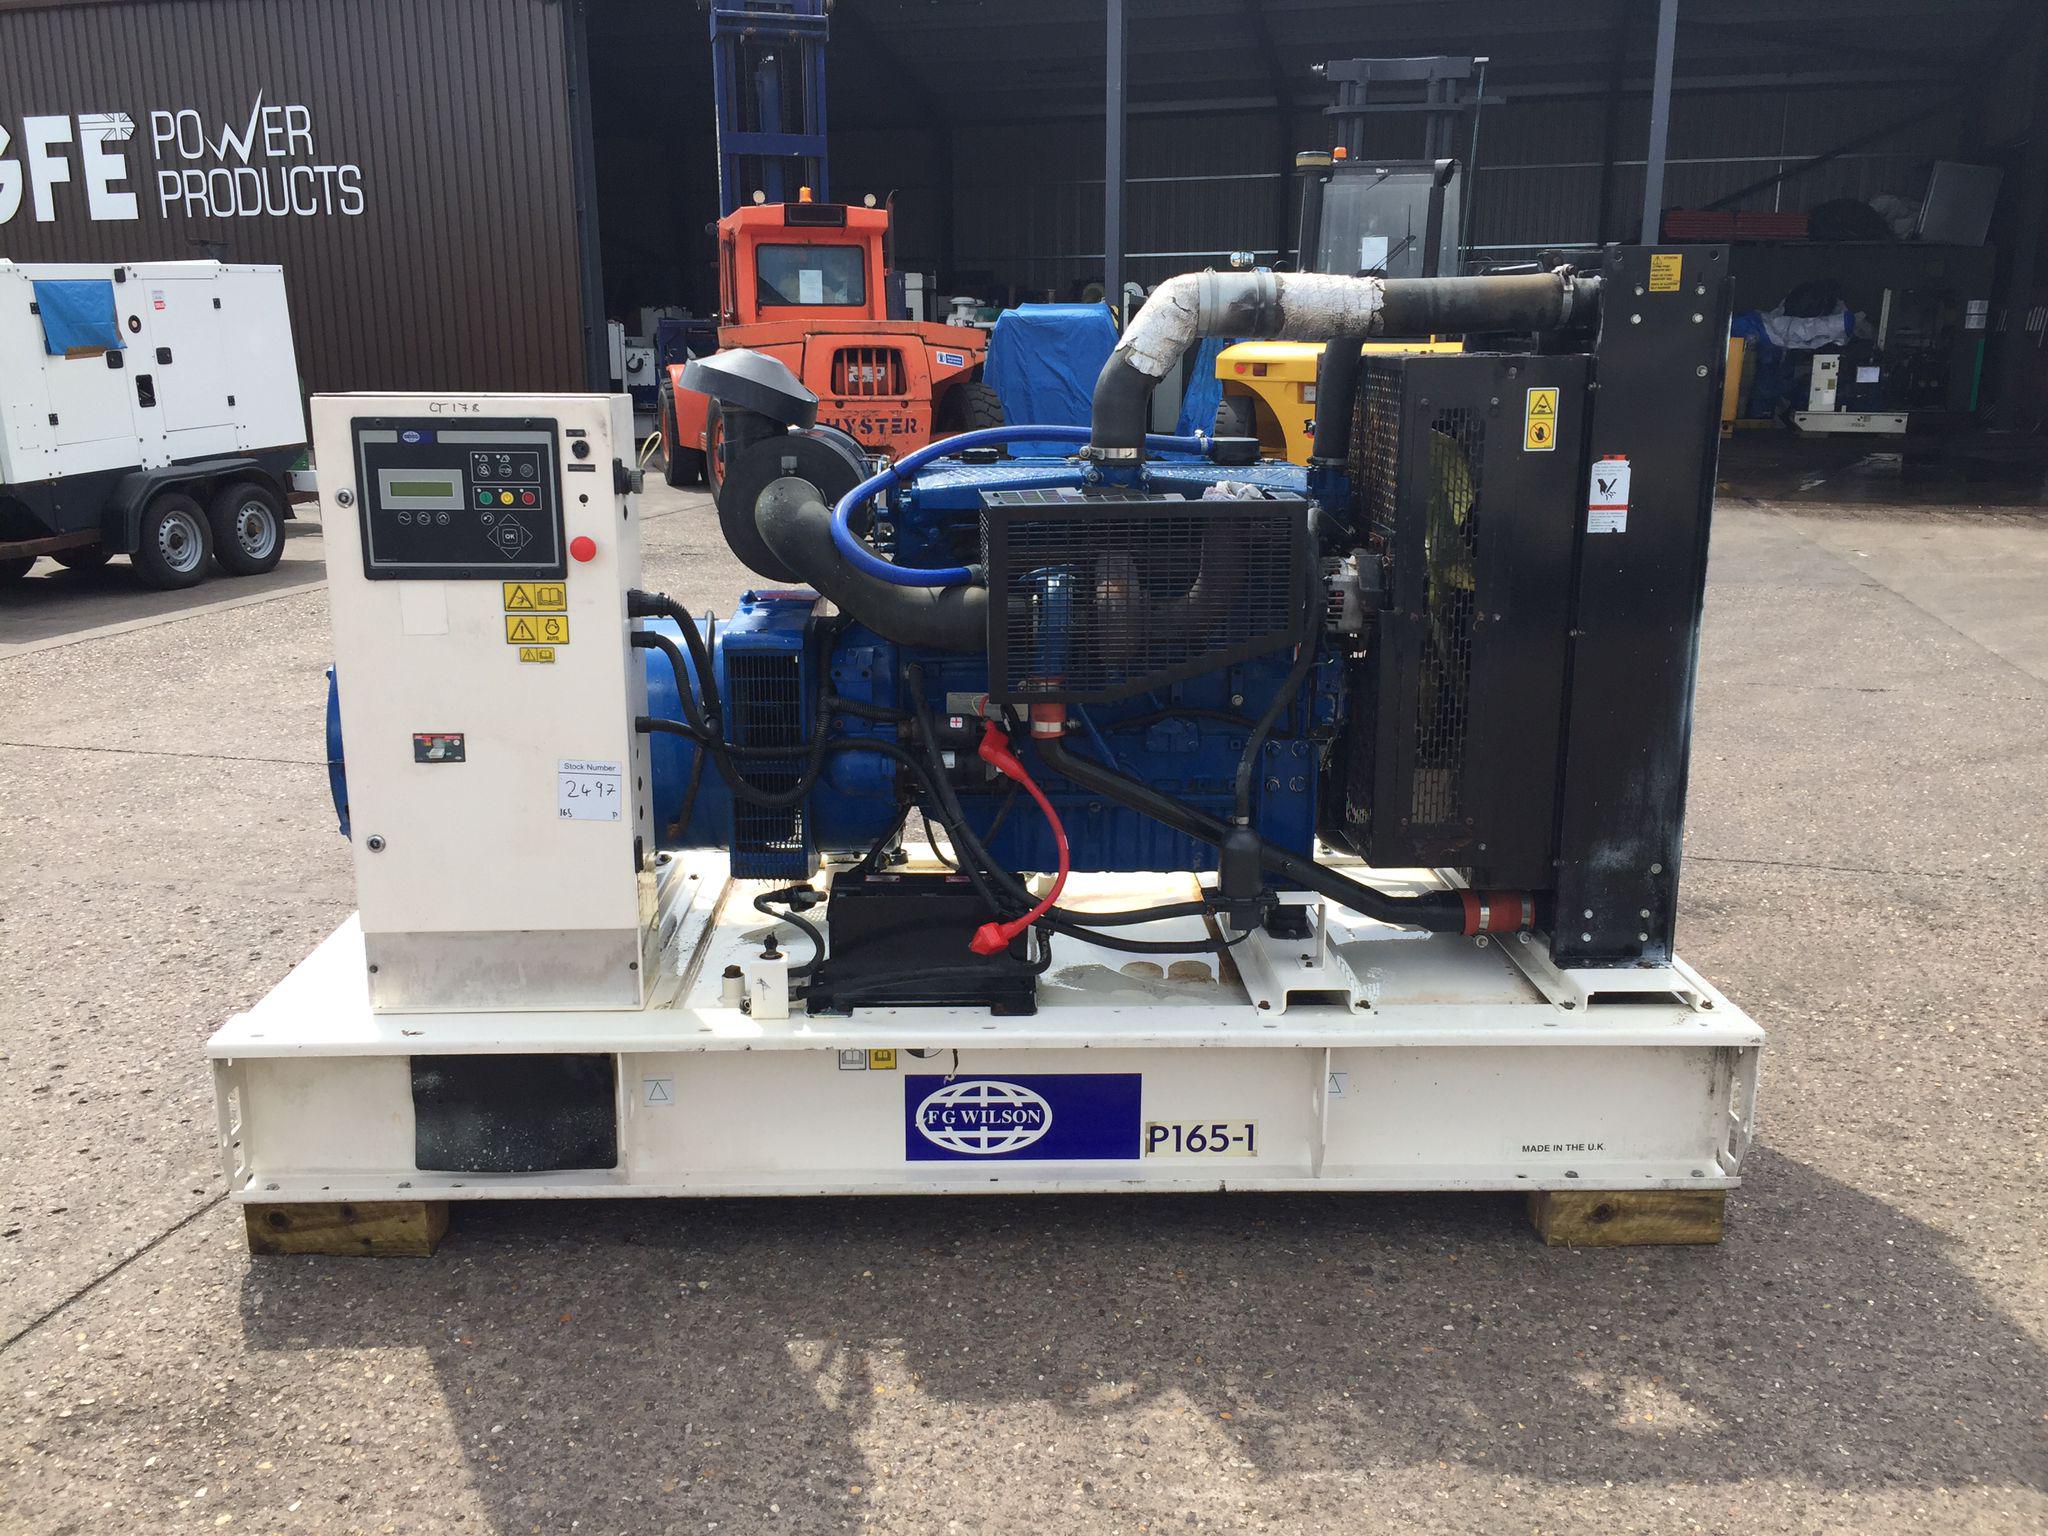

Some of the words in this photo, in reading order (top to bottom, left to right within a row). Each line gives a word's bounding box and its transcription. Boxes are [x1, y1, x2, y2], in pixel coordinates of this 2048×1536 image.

[151, 88, 314, 166] POWER
[158, 165, 365, 219] PRODUCTS
[586, 763, 616, 772] Number
[565, 780, 616, 798] 2497
[960, 1109, 1041, 1124] WILSON
[1149, 1123, 1254, 1153] P165-1
[1553, 1144, 1563, 1152] IN
